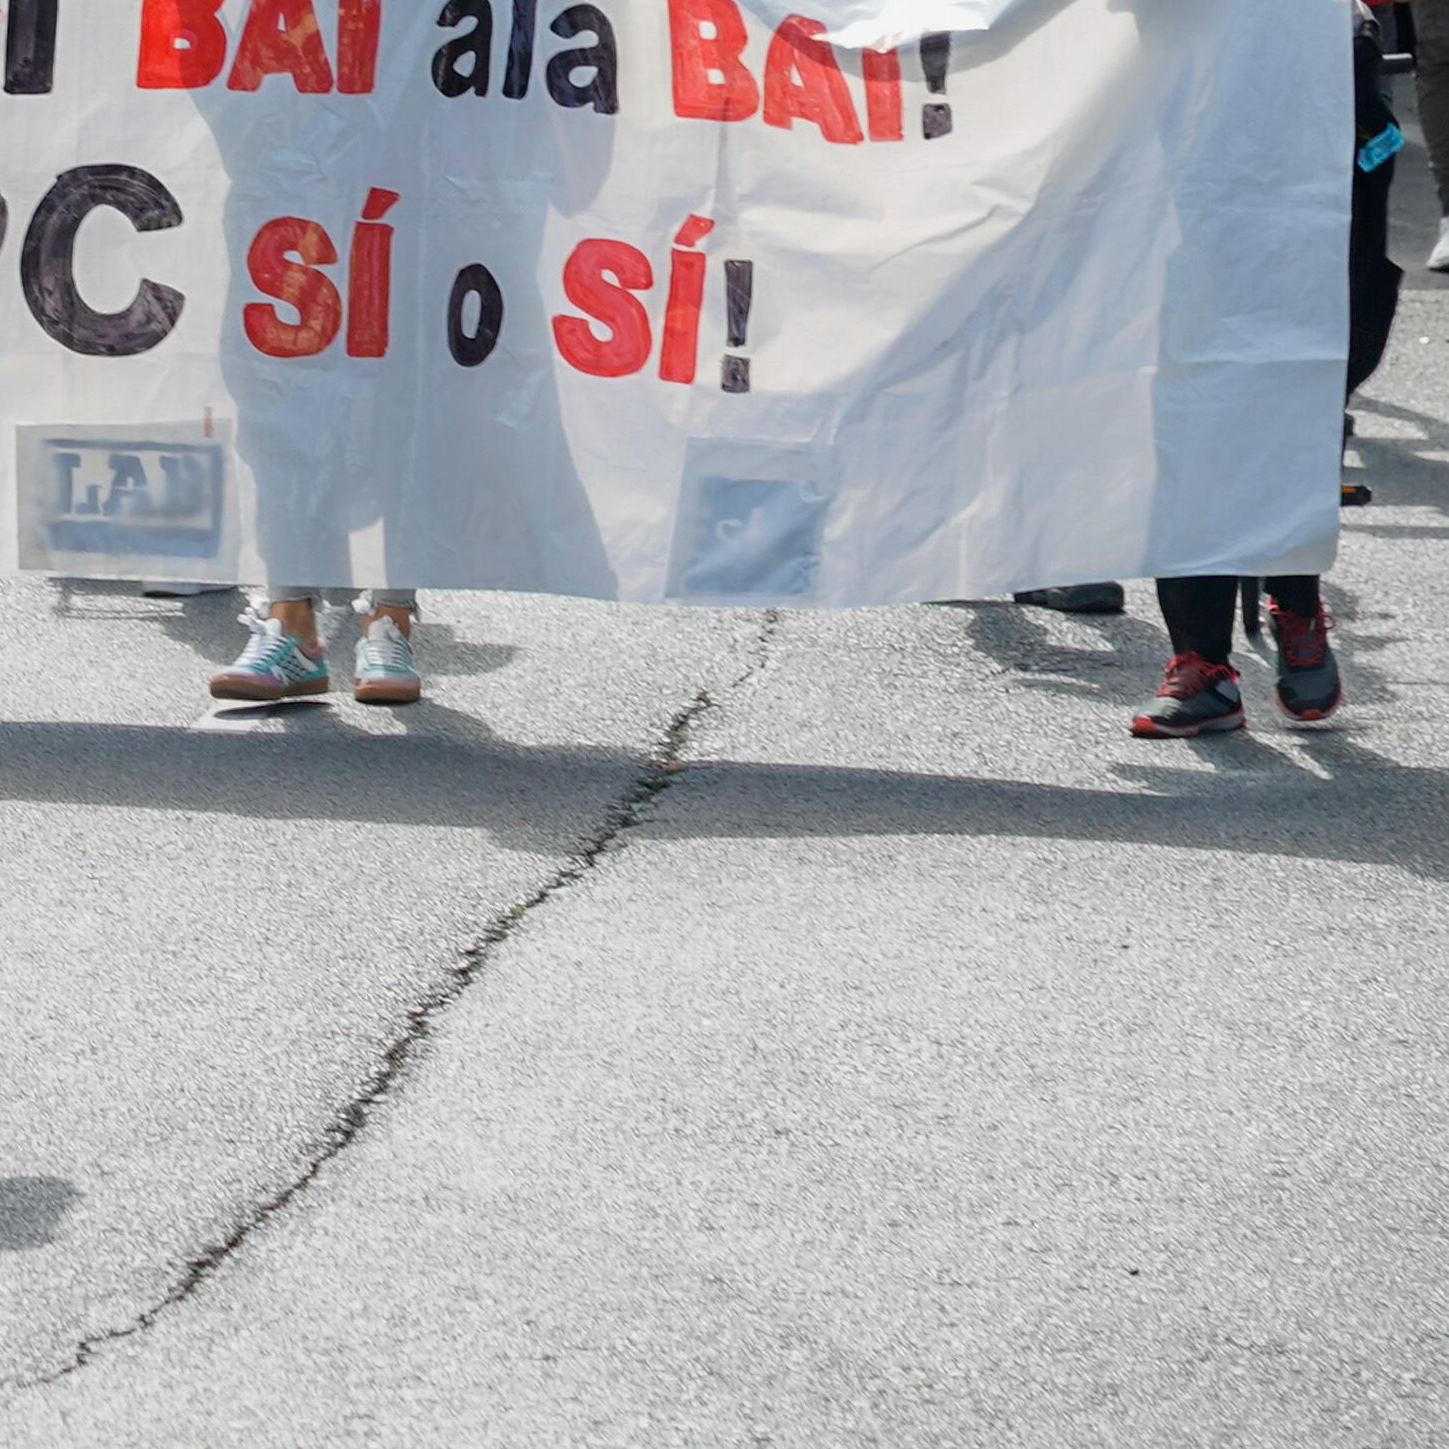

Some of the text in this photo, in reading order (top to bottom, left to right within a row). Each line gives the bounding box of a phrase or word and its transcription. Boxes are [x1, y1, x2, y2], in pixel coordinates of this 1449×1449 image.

[241, 185, 401, 359] SÍ
[447, 262, 504, 368] o
[551, 213, 754, 394] SÍ!
